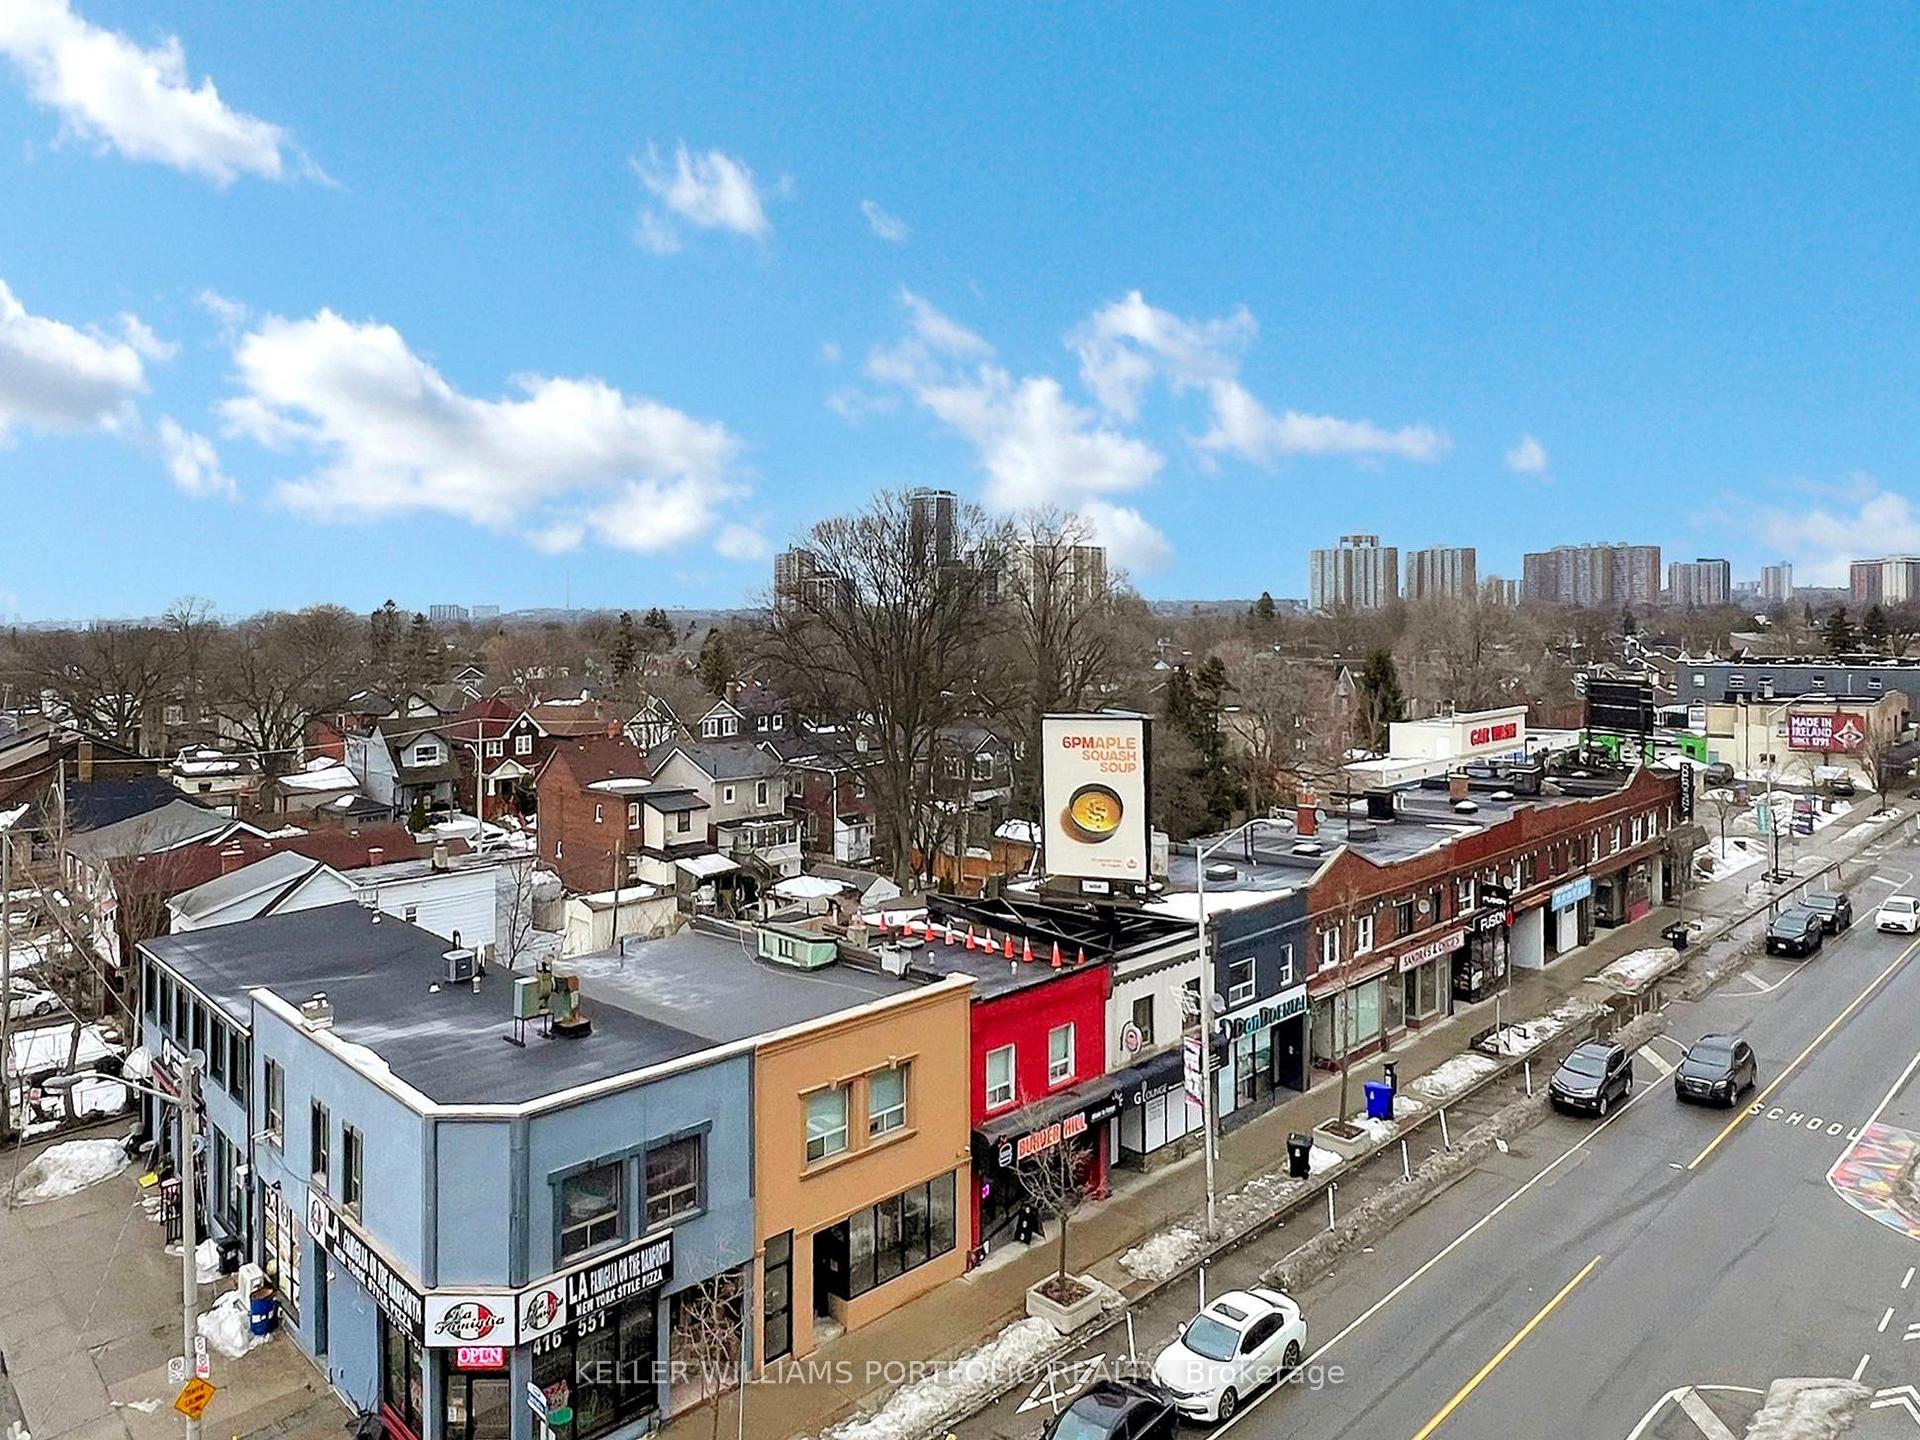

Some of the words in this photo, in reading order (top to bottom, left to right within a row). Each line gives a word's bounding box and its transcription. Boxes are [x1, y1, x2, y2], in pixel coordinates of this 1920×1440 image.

[1791, 716, 1819, 728] MADE
[1821, 717, 1832, 728] IN
[1791, 727, 1832, 738] IRELAND
[1082, 750, 1137, 762] SQUASH
[1100, 762, 1137, 774] SOUP
[1480, 909, 1506, 933] FUSION
[1063, 1111, 1088, 1139] HILL
[1749, 1102, 1859, 1141] SCHOOL
[326, 1207, 341, 1246] LA
[569, 1272, 589, 1305] LA
[575, 1301, 594, 1317] NEW
[596, 1291, 616, 1308] YORK
[617, 1279, 641, 1299] STYLE
[642, 1268, 664, 1288] PIZZA
[367, 1277, 389, 1308] STYLE
[390, 1301, 413, 1332] PIZZA
[434, 1314, 505, 1334] Famiglia
